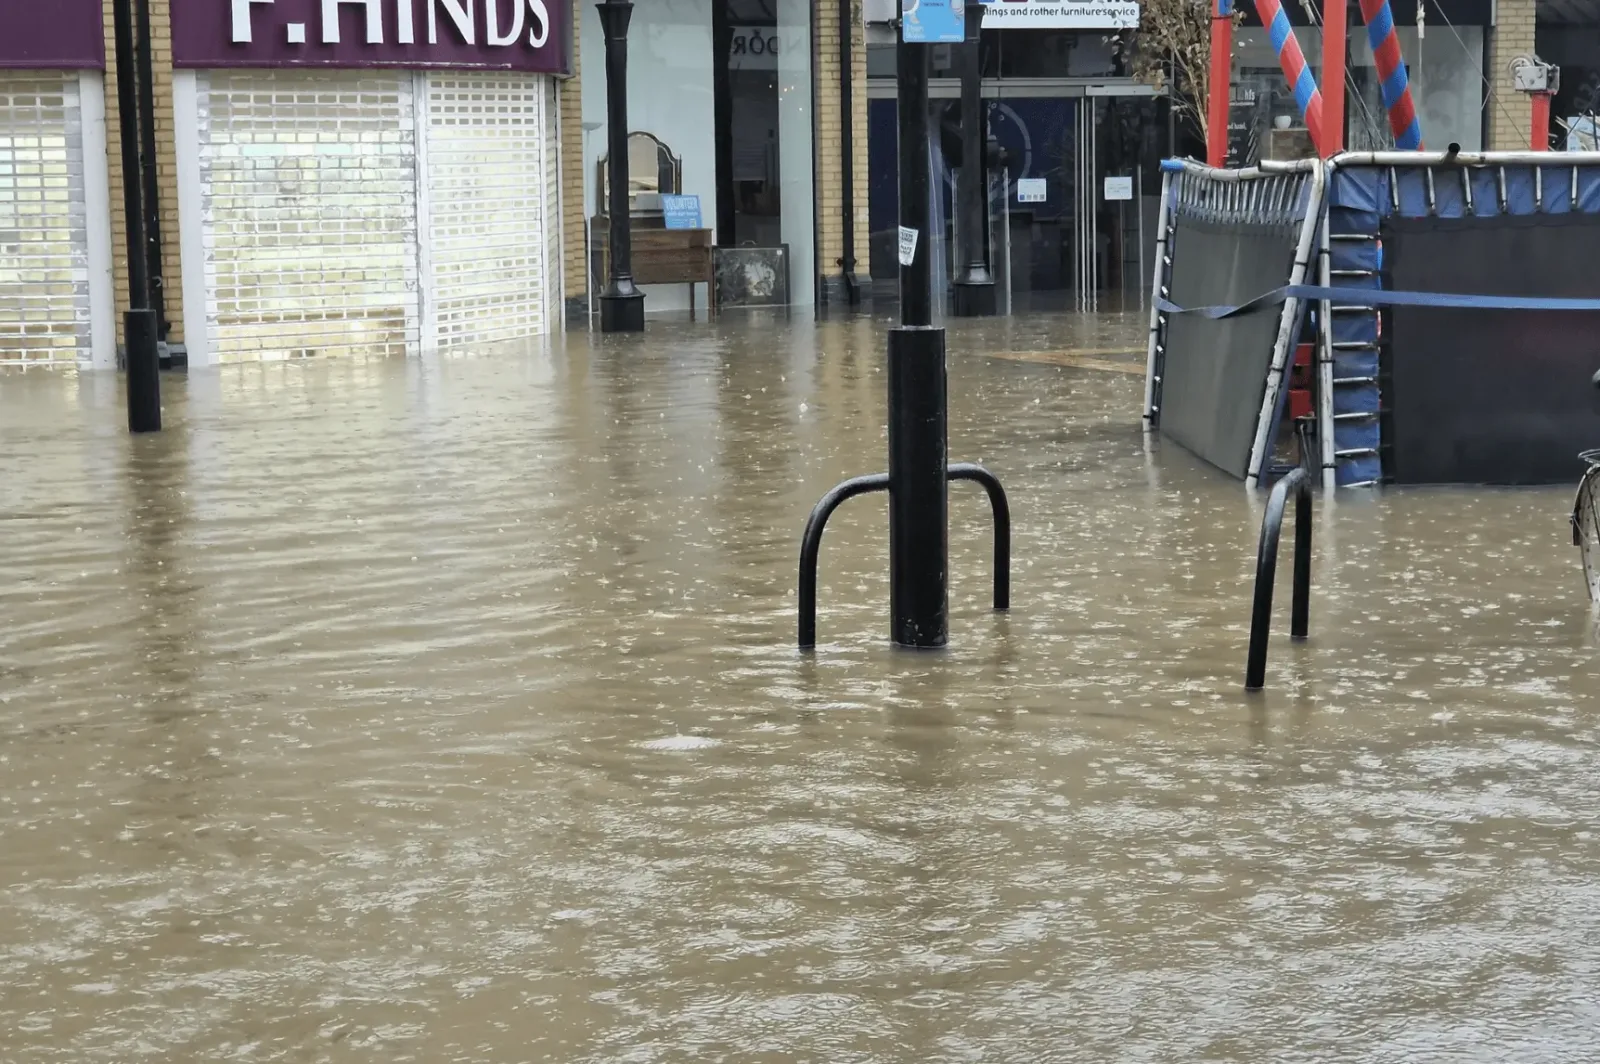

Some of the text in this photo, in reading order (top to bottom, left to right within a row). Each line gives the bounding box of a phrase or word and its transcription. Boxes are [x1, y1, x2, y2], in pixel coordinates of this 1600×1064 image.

[1010, 6, 1028, 16] and
[1030, 6, 1059, 16] rother
[1061, 6, 1101, 16] furniture
[1102, 6, 1136, 16] service
